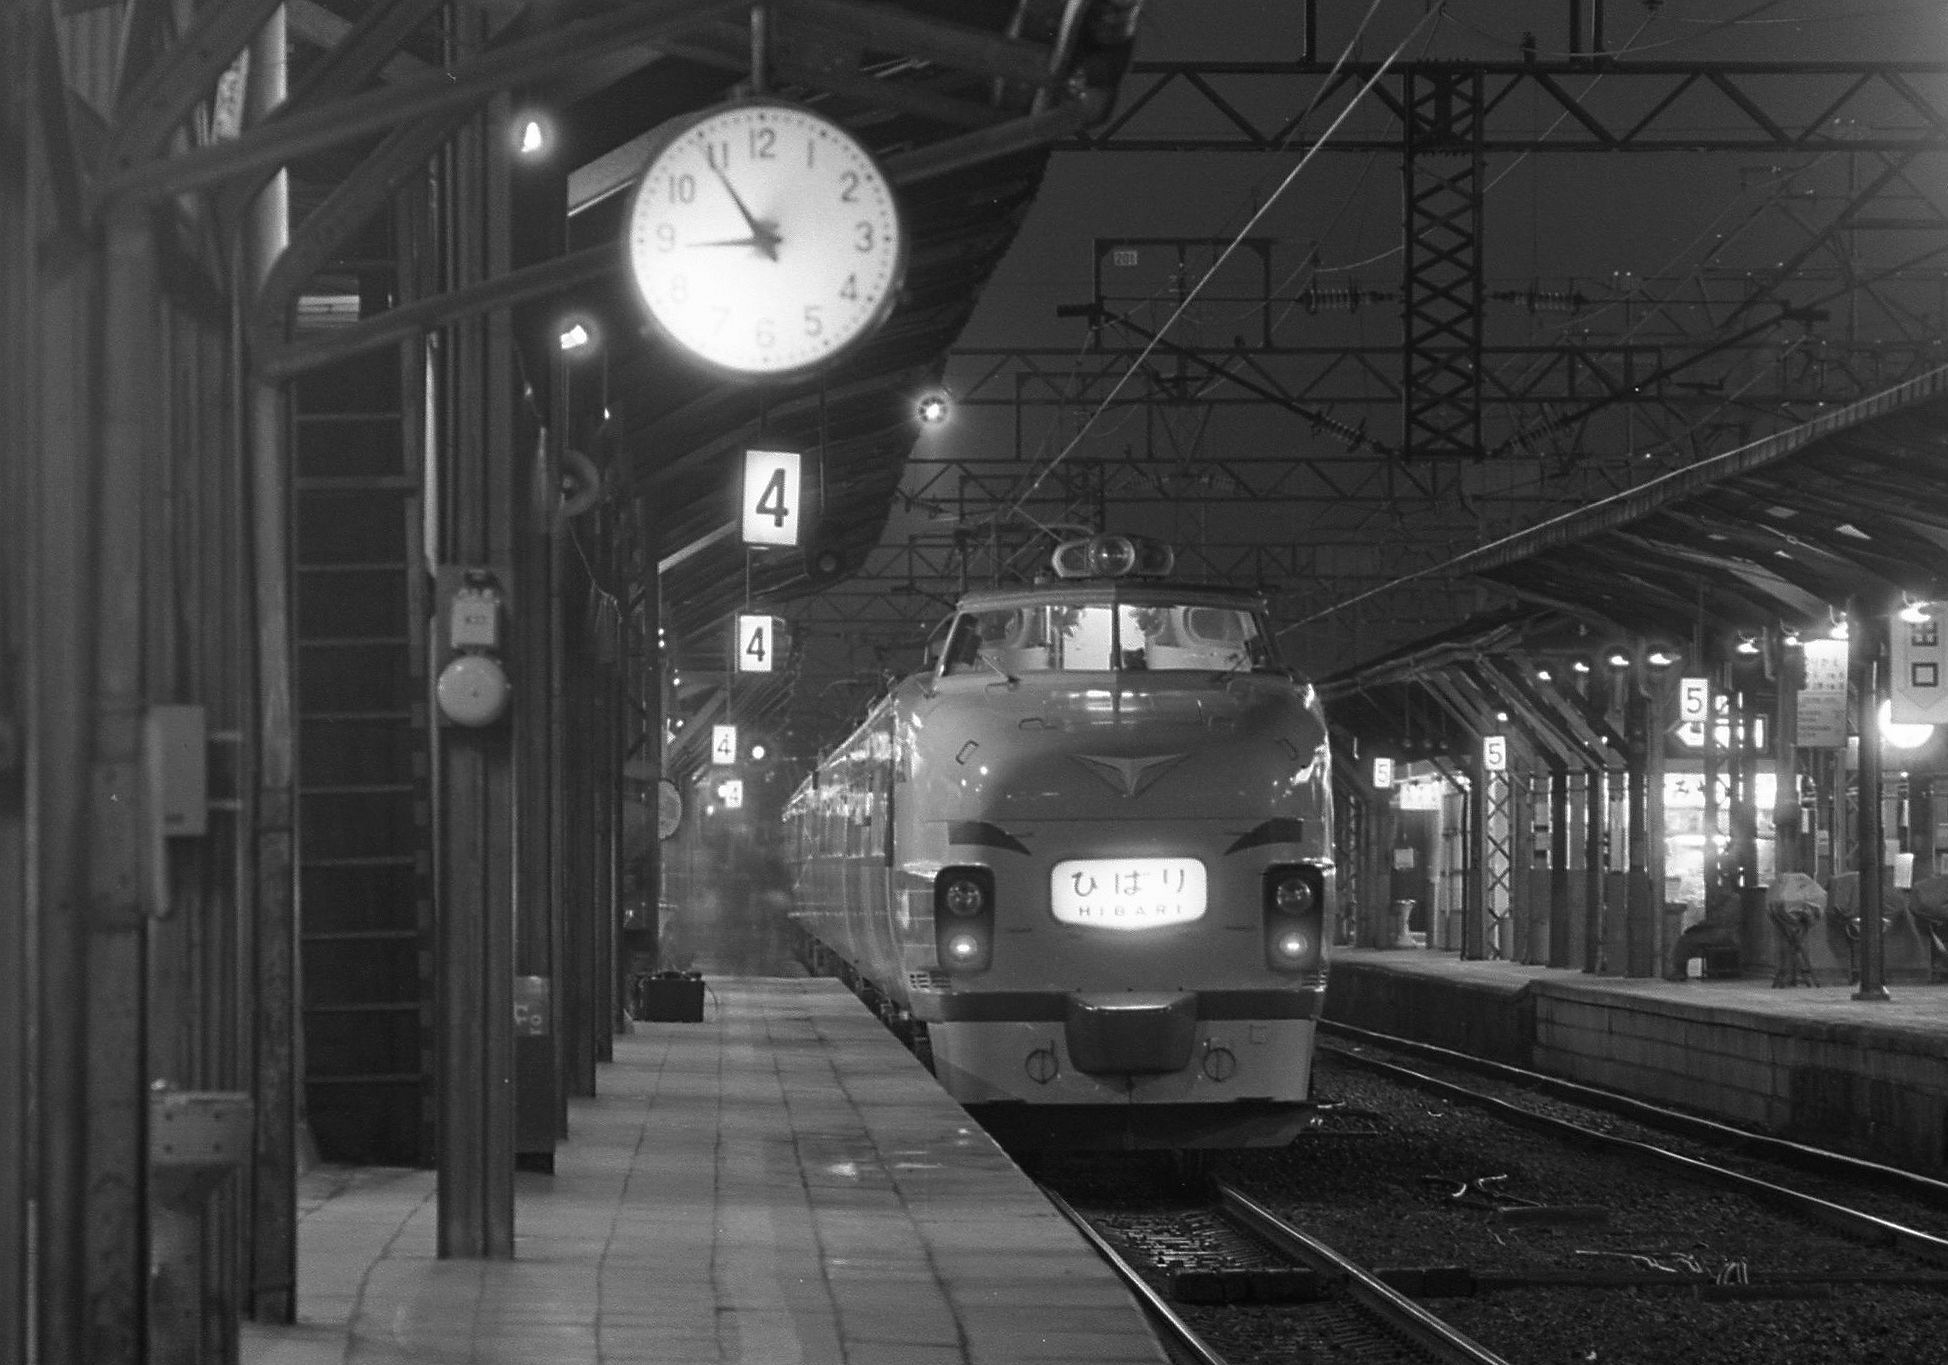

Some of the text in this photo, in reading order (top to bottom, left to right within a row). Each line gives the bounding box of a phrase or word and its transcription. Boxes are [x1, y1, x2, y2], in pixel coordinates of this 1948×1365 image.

[749, 127, 777, 159] 12
[806, 139, 815, 168] 1
[669, 174, 696, 204] 10
[840, 171, 860, 202] 2
[657, 223, 676, 252] 9
[855, 221, 875, 253] 3
[840, 273, 858, 301] 4
[712, 306, 729, 337] 7
[757, 317, 775, 348] 6
[804, 305, 823, 337] 5
[756, 468, 789, 528] 4
[746, 626, 766, 662] 4
[1687, 687, 1702, 714] 5
[717, 733, 732, 756] 4
[1488, 743, 1503, 765] 5
[1378, 763, 1389, 784] 5
[1072, 868, 1185, 897] ひばり
[1079, 904, 1182, 917] HIBARI
